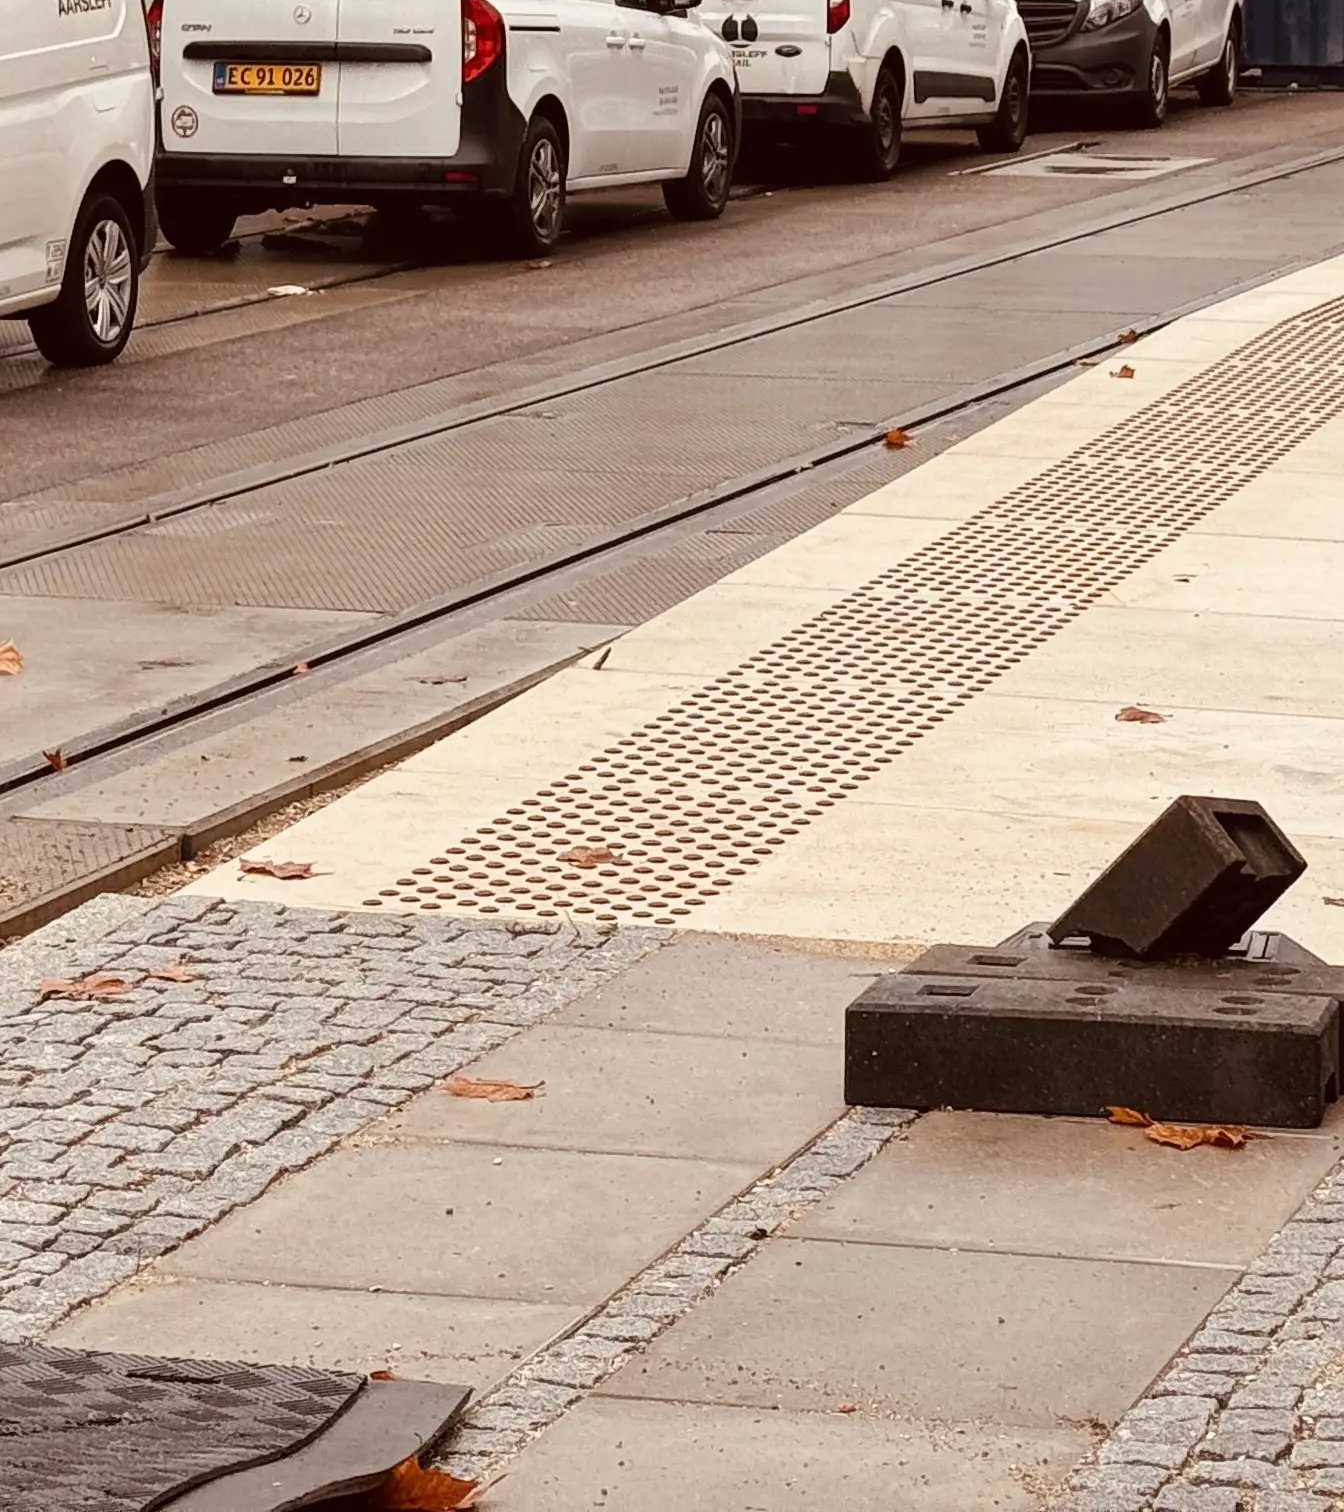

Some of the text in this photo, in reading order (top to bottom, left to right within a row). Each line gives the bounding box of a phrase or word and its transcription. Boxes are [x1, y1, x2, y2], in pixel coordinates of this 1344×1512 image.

[227, 67, 316, 88] EC 91 026
